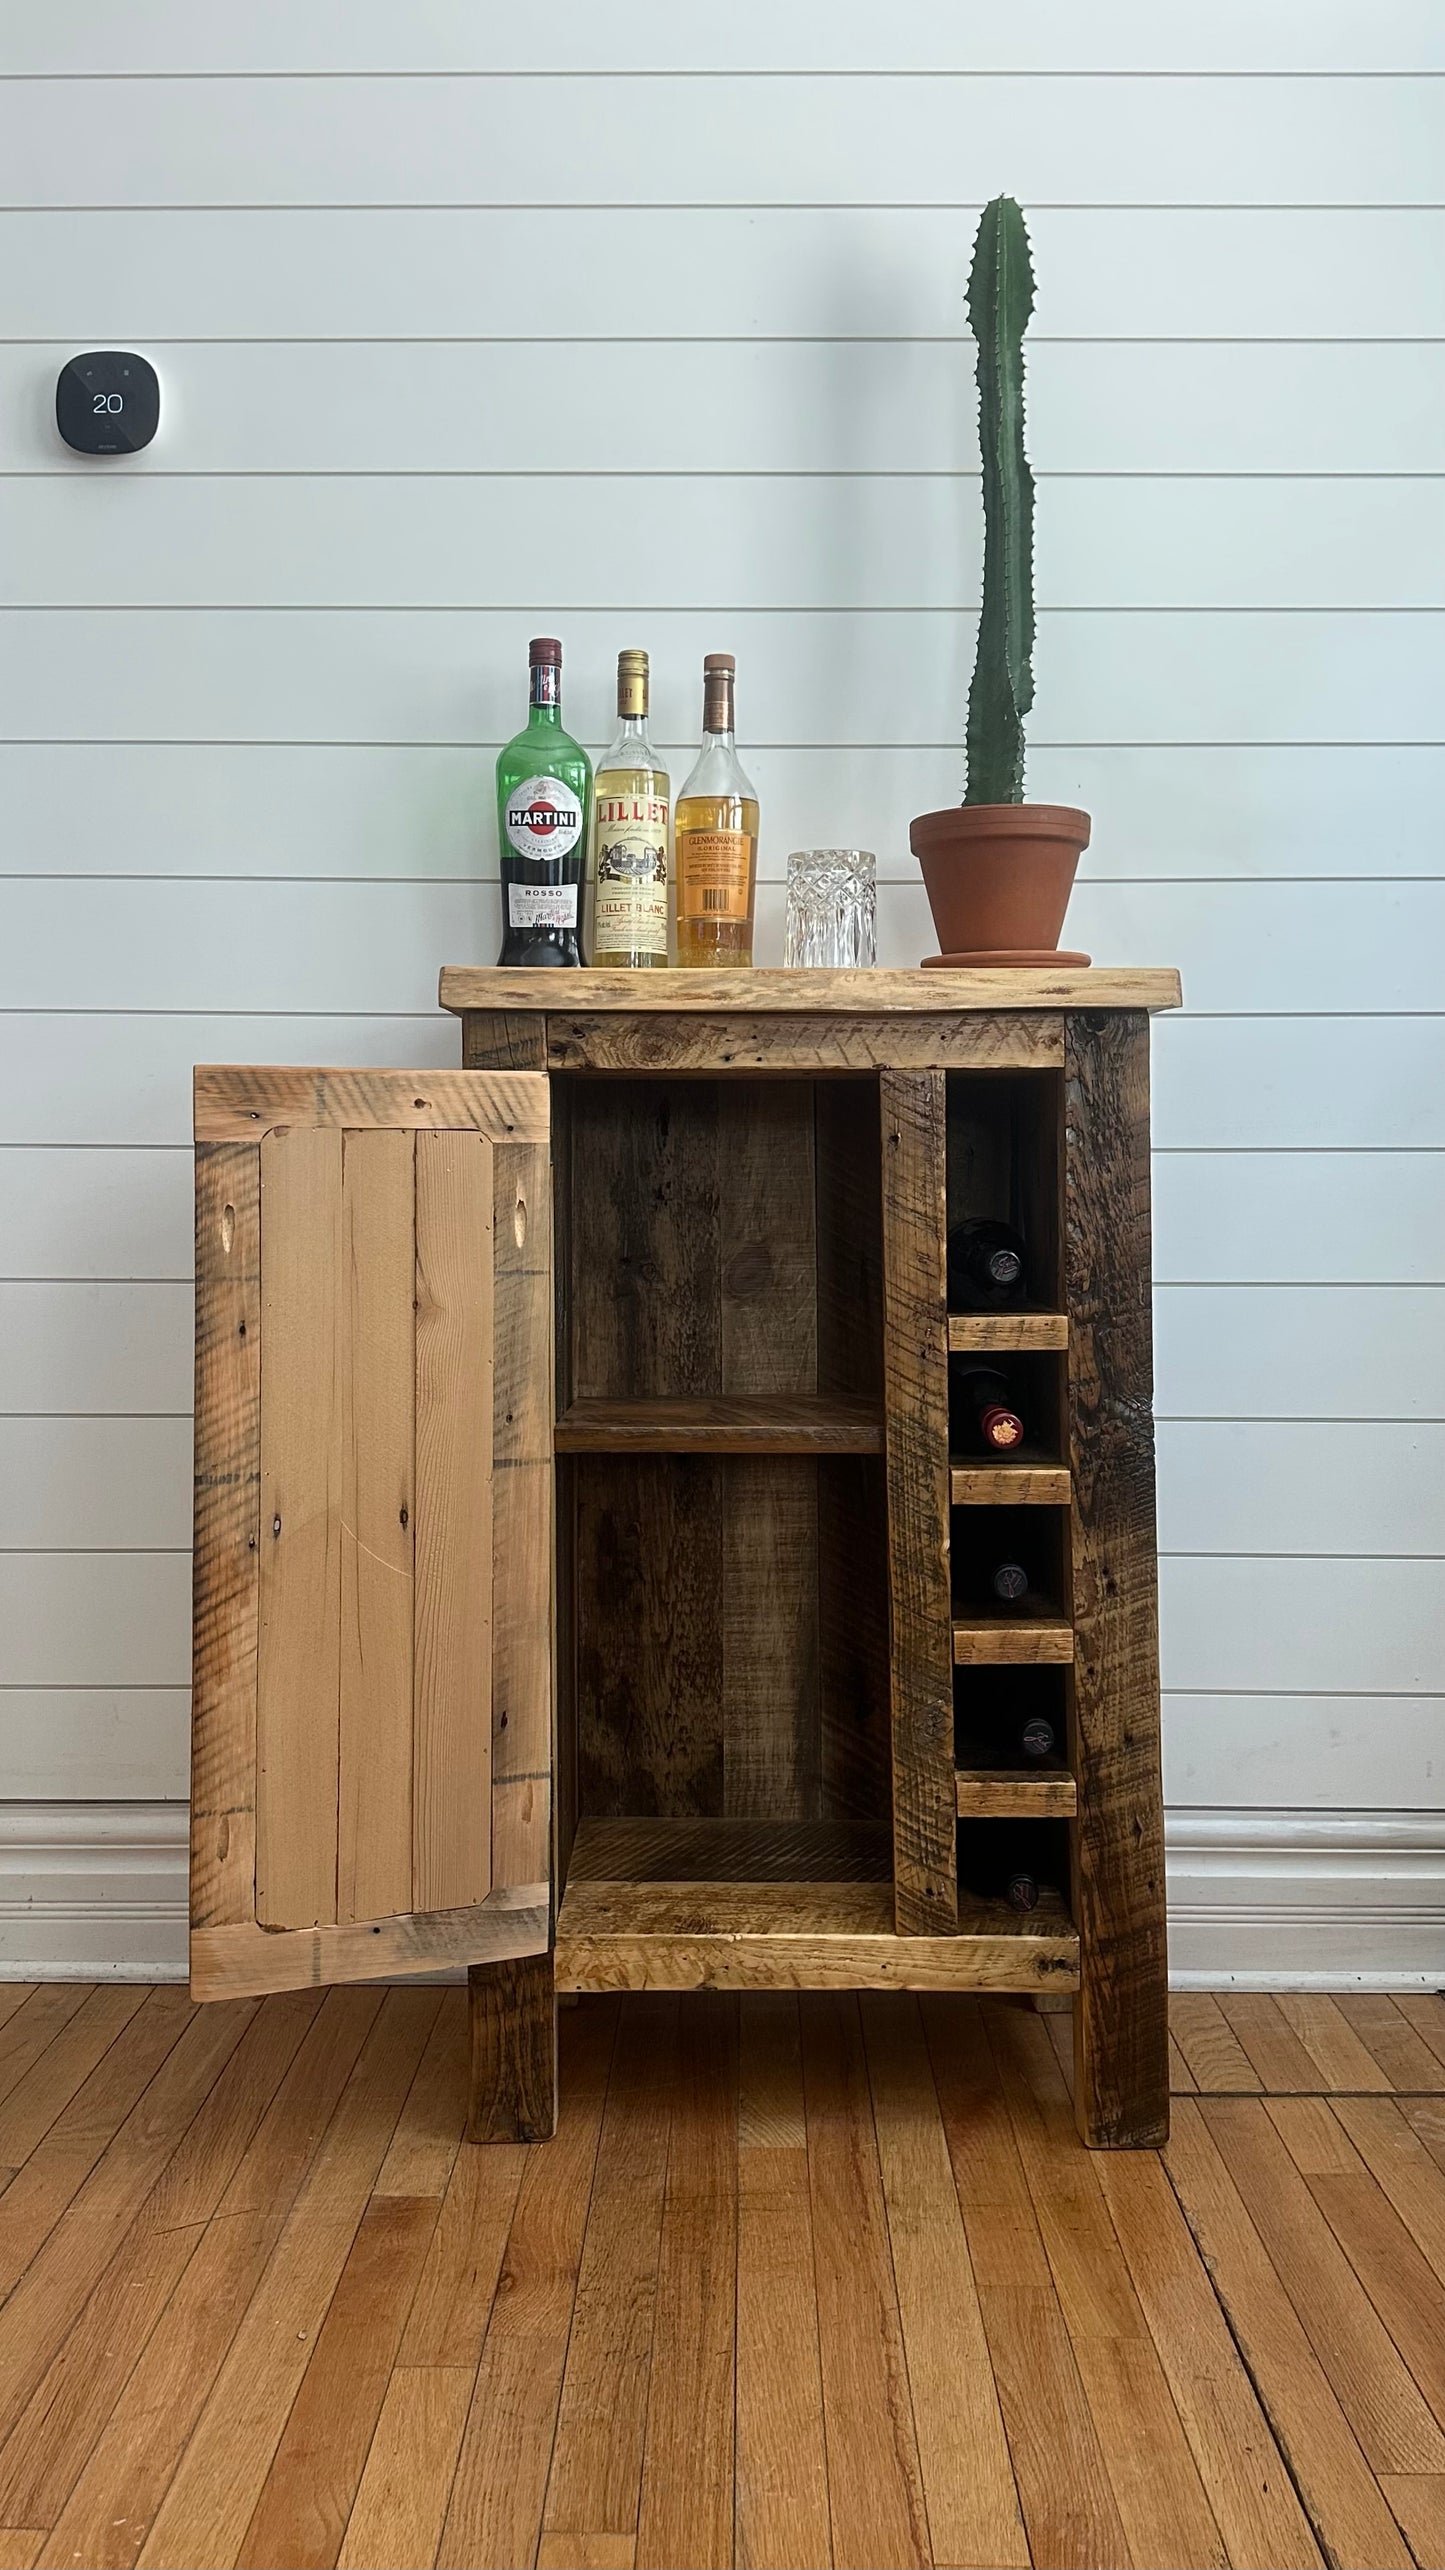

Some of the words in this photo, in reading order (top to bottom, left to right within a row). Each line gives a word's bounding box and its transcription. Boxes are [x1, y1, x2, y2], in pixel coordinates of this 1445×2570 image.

[93, 394, 123, 413] 20
[511, 812, 574, 826] MARTINI
[598, 801, 667, 825] LILLET
[689, 836, 744, 845] GLENMORANGIE
[602, 903, 632, 913] LILLET
[636, 903, 664, 915] BLANC
